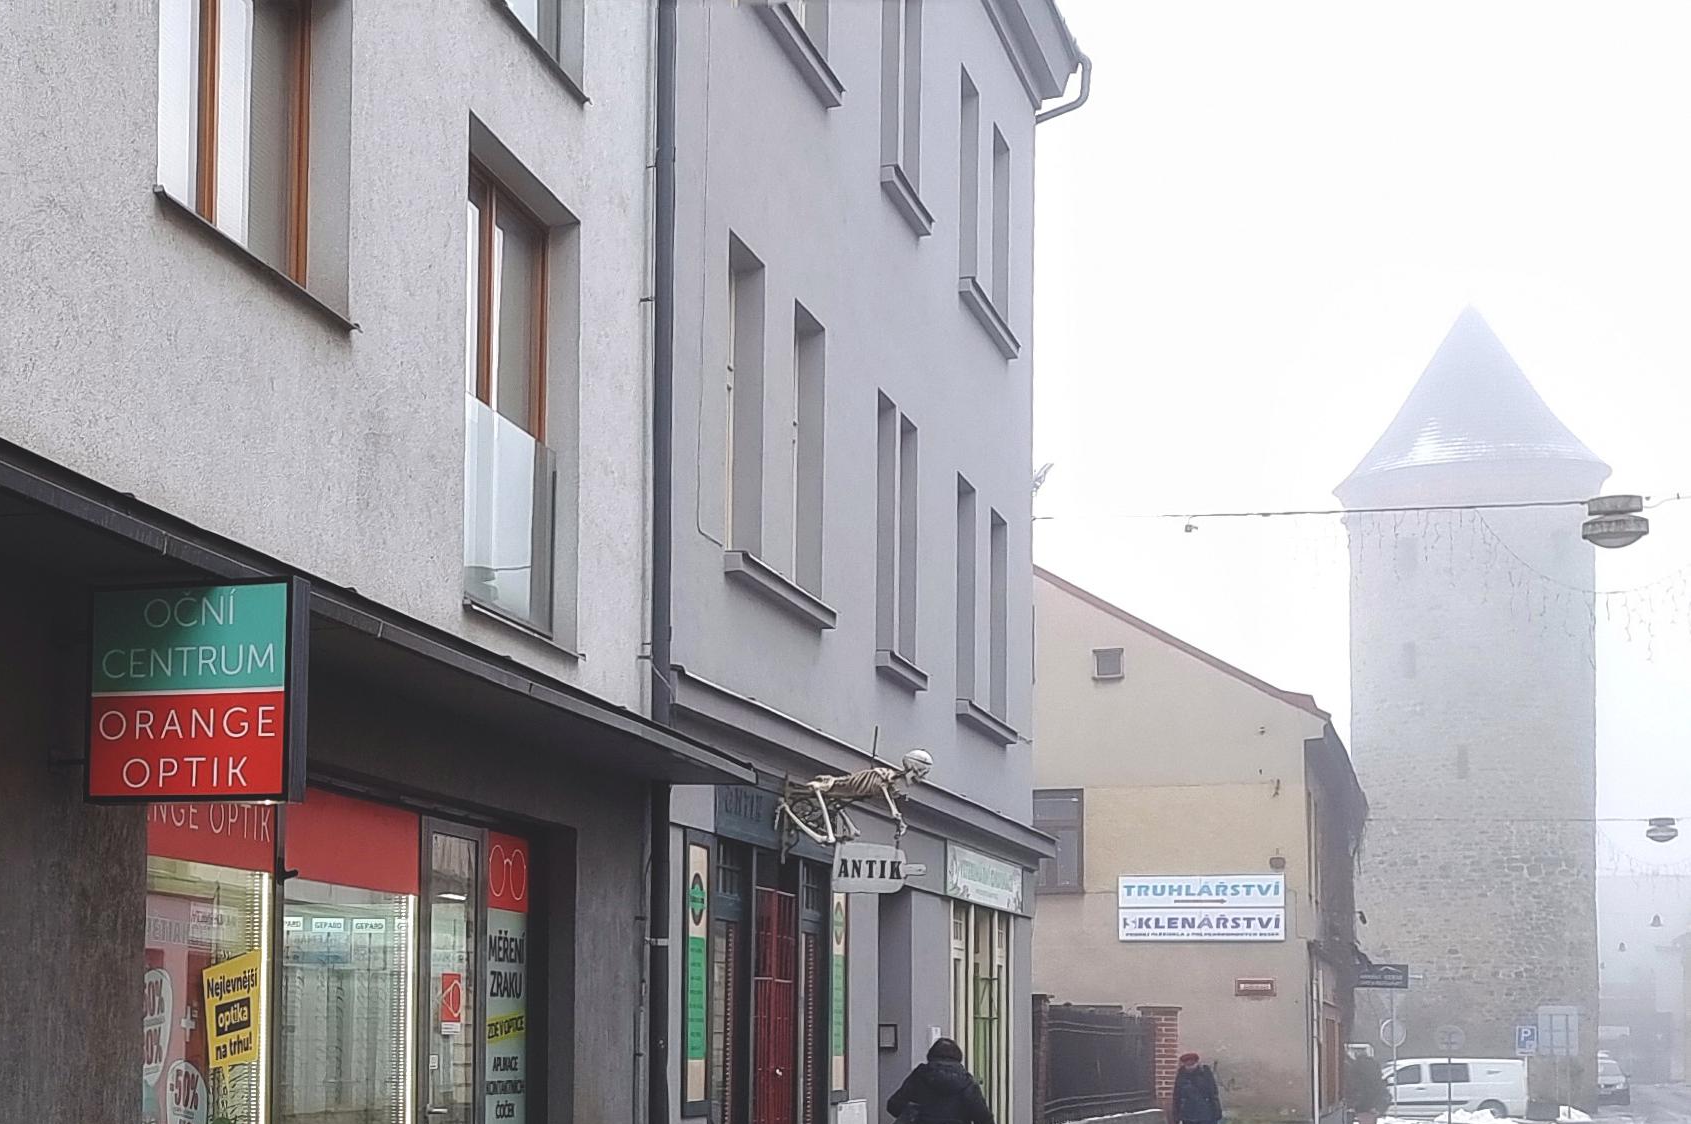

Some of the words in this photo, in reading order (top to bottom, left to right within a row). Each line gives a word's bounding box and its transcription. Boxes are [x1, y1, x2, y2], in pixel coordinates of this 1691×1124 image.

[144, 588, 237, 629] OČNÍ
[101, 642, 275, 679] CENTRUM
[99, 706, 276, 741] ORANGE
[122, 756, 248, 788] OPTIK
[147, 804, 199, 830] NGE
[209, 804, 271, 843] OPTIK
[838, 858, 903, 880] ANTIK
[1123, 880, 1281, 897] TRUHLÁŘSTVÍ
[1123, 913, 1281, 930] SKLENÁŘSTVÍ
[488, 929, 526, 964] MĚŘENÍ
[206, 967, 258, 1001] Nejlevnější
[489, 970, 523, 999] ZRAKU
[217, 1002, 249, 1031] optika
[215, 1043, 228, 1060] na
[229, 1031, 253, 1056] trhu!
[1520, 1028, 1532, 1041] P
[169, 1068, 200, 1111] -50%
